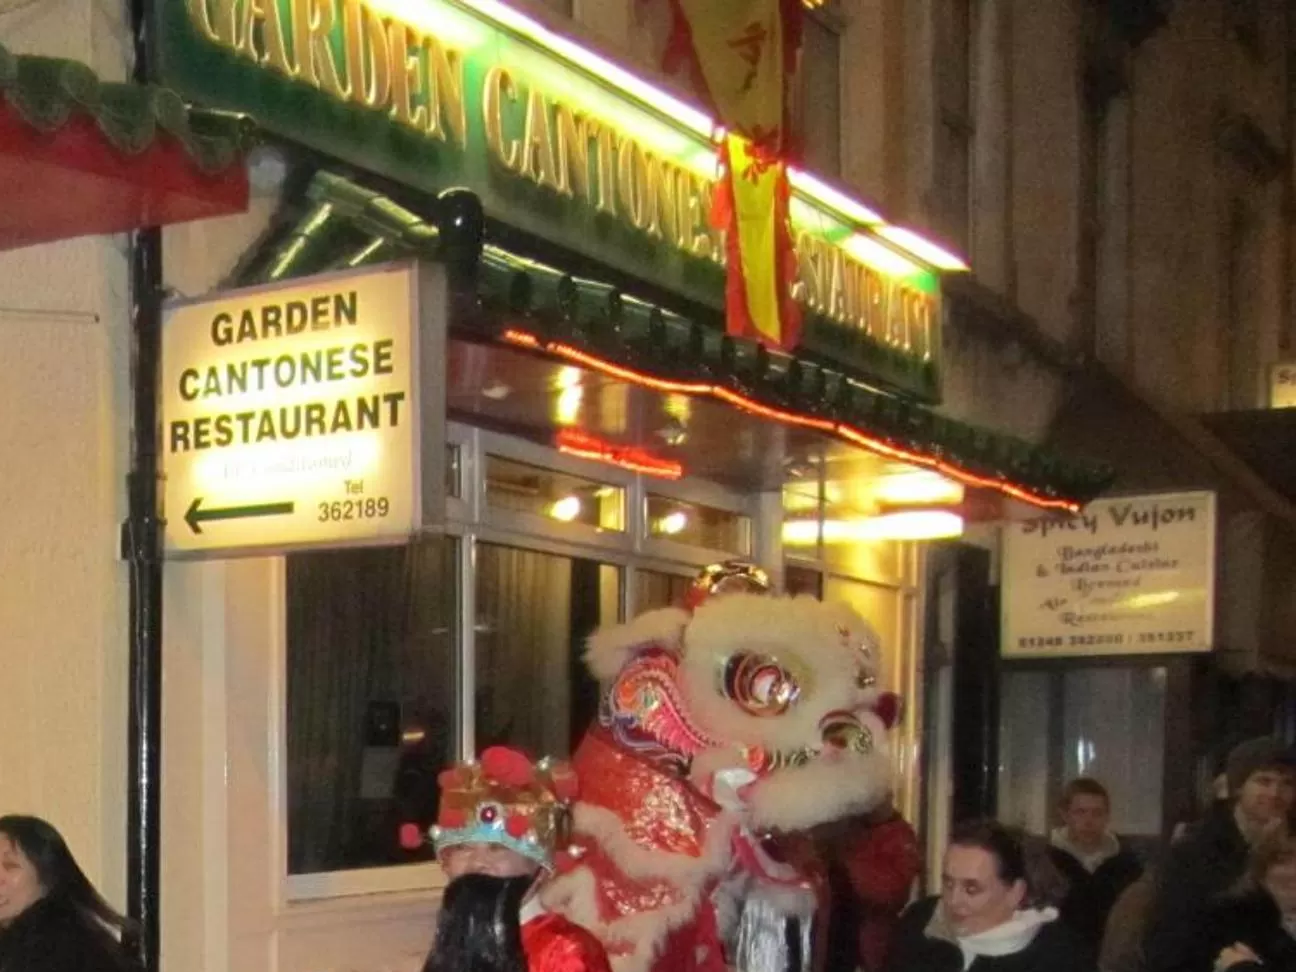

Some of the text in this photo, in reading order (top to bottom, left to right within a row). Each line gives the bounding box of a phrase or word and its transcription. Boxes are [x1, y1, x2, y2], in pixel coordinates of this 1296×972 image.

[211, 291, 358, 346] GARDEN
[179, 339, 394, 401] CANTONESE
[170, 392, 405, 452] RESTAURANT
[318, 497, 390, 522] 362189
[344, 480, 364, 495] Tel
